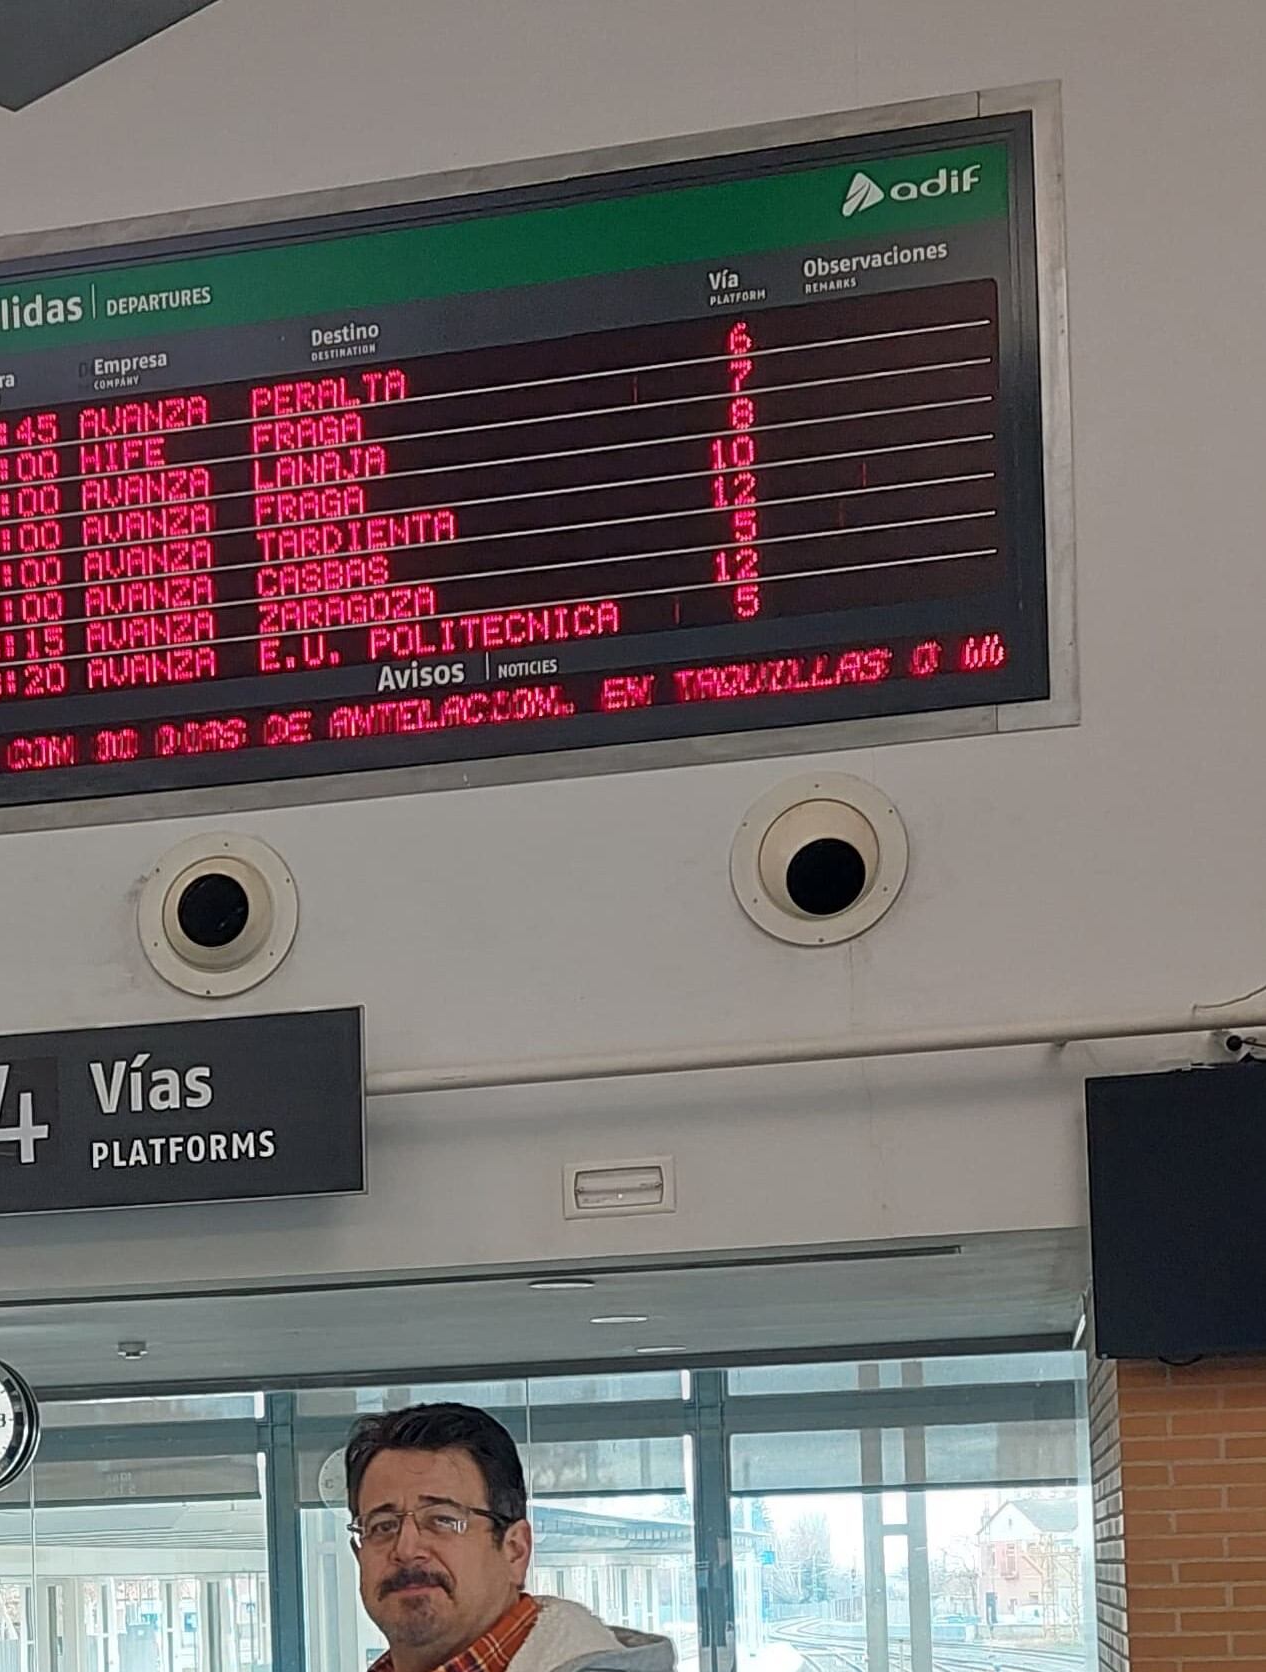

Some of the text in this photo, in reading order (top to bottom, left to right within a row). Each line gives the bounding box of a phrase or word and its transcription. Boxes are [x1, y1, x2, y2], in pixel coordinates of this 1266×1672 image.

[890, 164, 982, 201] adif
[93, 375, 140, 390] COMPANY
[311, 343, 376, 362] DESTINATION
[709, 289, 766, 306] PLATFORM
[804, 277, 857, 294] REMARKS
[94, 352, 168, 375] Empresa
[311, 322, 380, 347] Destino
[708, 269, 739, 291] Vía
[803, 242, 948, 278] Observaciones
[105, 286, 212, 318] DEPARTURES
[79, 394, 207, 439] AVANZA
[251, 368, 407, 418] PERALTA
[729, 321, 752, 355] 6
[80, 436, 165, 474] HIFE
[252, 411, 363, 454] FRAGA
[730, 358, 752, 393] 7
[81, 466, 211, 511] AVANZA
[253, 444, 387, 491] LANAJA
[732, 397, 754, 430] 8
[83, 502, 212, 546] AVANZA
[255, 485, 364, 527] FRAGA
[713, 433, 756, 470] 10
[84, 538, 213, 582] AVANZA
[256, 510, 456, 561] TARDIENTA
[714, 471, 757, 508] 12
[85, 573, 214, 617] AVANZA
[257, 554, 390, 598] CASBAS
[734, 508, 758, 542] 5
[86, 609, 215, 653] AVANZA
[258, 584, 436, 634] ZARAGOZA
[716, 547, 759, 583] 12
[87, 645, 216, 690] AVANZA
[259, 634, 341, 673] E.U.
[369, 600, 620, 661] POLITECNICA
[736, 583, 761, 619] 5
[377, 658, 559, 692] Avisos NOTICIES
[89, 1053, 213, 1114] Vías
[91, 1130, 276, 1169] PLATFORMS
